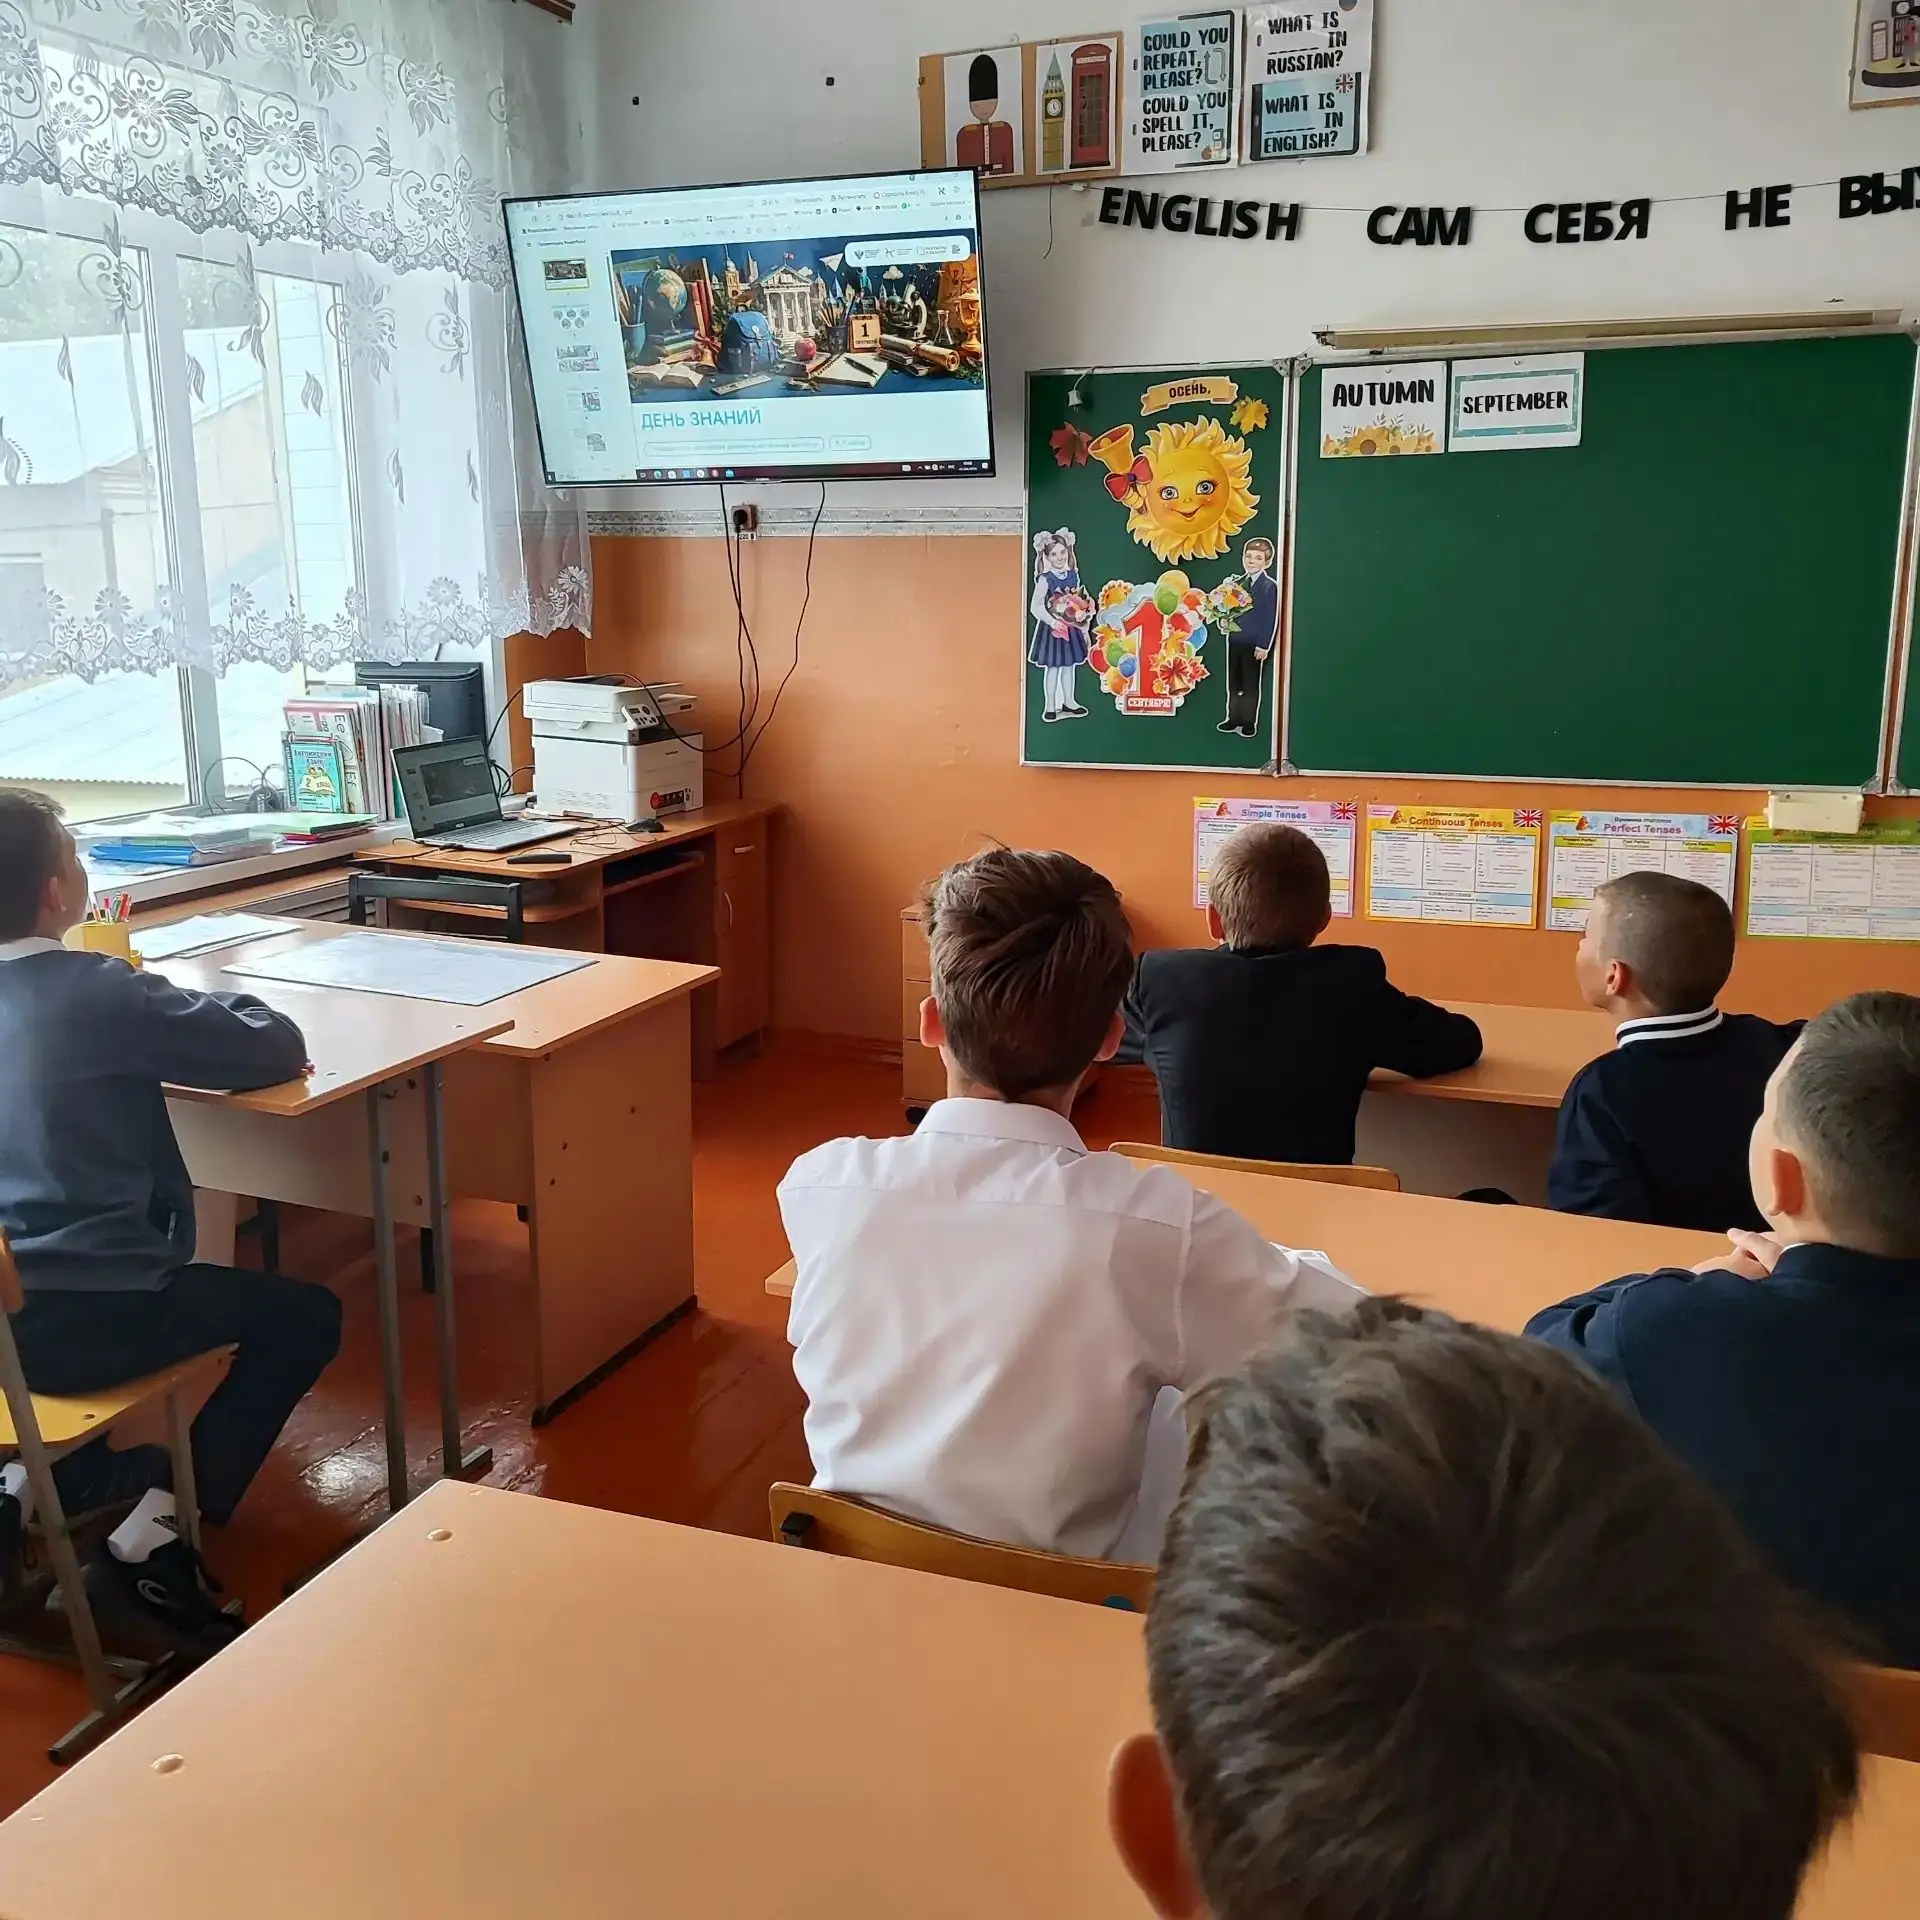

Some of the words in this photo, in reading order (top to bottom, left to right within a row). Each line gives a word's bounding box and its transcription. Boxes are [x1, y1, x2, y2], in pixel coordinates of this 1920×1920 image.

[1268, 14, 1314, 35] WHAT
[1321, 11, 1339, 29] IS
[1144, 31, 1191, 51] COULD
[1198, 27, 1229, 46] YOU
[1328, 31, 1347, 48] IN
[1144, 50, 1202, 71] REPEAT,
[1266, 50, 1344, 75] RUSSIAN?
[1144, 68, 1203, 91] PLEASE?
[1143, 95, 1189, 115] COULD
[1196, 92, 1226, 110] YOU
[1265, 94, 1310, 114] WHAT
[1318, 92, 1335, 110] IS
[1142, 115, 1185, 134] SPELL
[1192, 112, 1214, 130] IT,
[1324, 111, 1343, 128] IN
[1142, 131, 1202, 153] PLEASE?
[1263, 130, 1339, 153] ENGLISH?
[1098, 186, 1300, 241] ENGLISH
[1367, 204, 1473, 247] САМ
[1523, 198, 1650, 244] СЕБЯ
[1724, 184, 1792, 231] НЕ
[860, 322, 870, 337] 1
[1332, 379, 1435, 408] AUTUMN
[1463, 390, 1569, 414] SEPTEMBER
[641, 412, 685, 429] ДЕНЬ
[690, 406, 762, 426] ЗНАНИЙ
[1123, 599, 1164, 697] 1
[1241, 809, 1272, 819] Simple
[1275, 810, 1307, 820] Tenses
[1409, 816, 1466, 827] Continuous
[1468, 818, 1504, 828] Tenses
[1603, 823, 1641, 833] Perfect
[1645, 825, 1682, 835] Tenses
